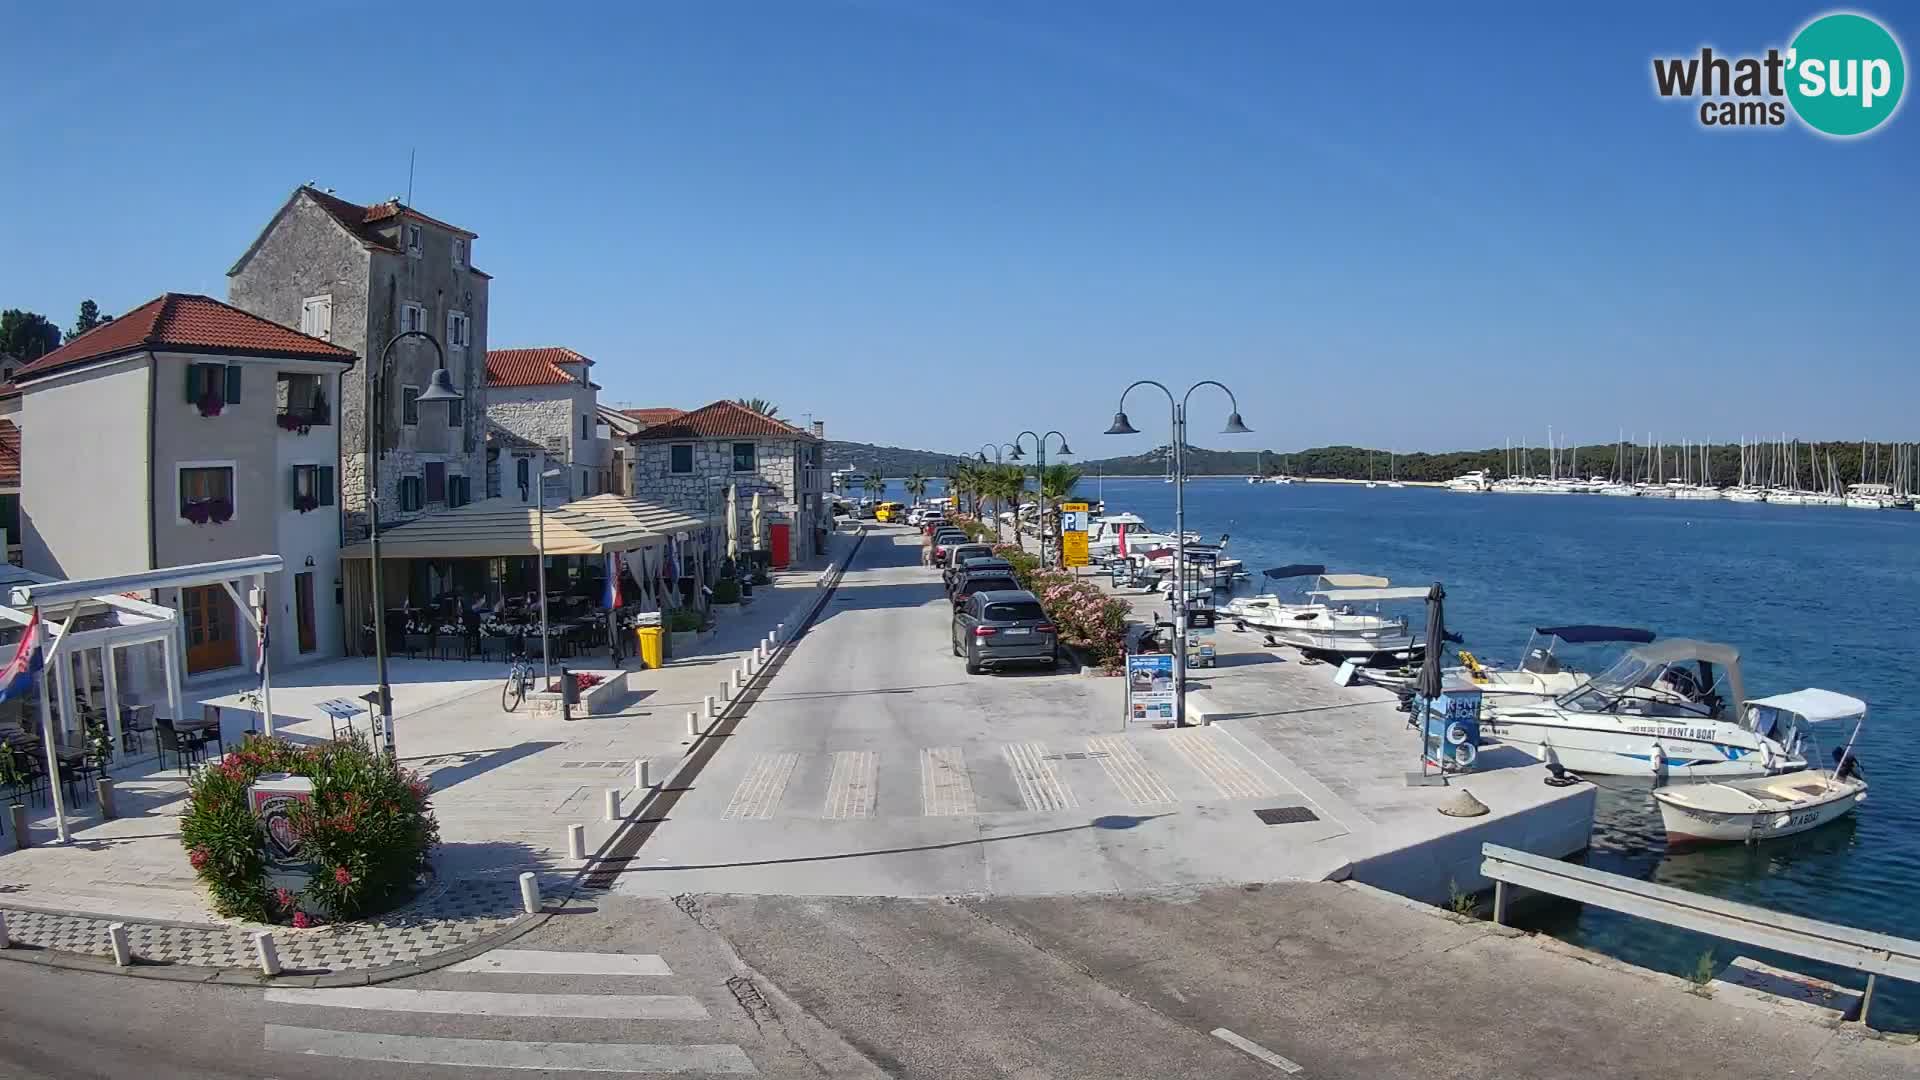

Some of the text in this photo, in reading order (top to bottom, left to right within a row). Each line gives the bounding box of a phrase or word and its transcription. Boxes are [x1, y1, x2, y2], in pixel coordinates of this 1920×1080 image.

[1065, 514, 1075, 530] P
[1447, 698, 1479, 709] RENT
[1446, 709, 1478, 719] A BOAT
[1667, 727, 1687, 737] RENT
[1688, 729, 1694, 738] A
[1696, 729, 1717, 740] BOAT
